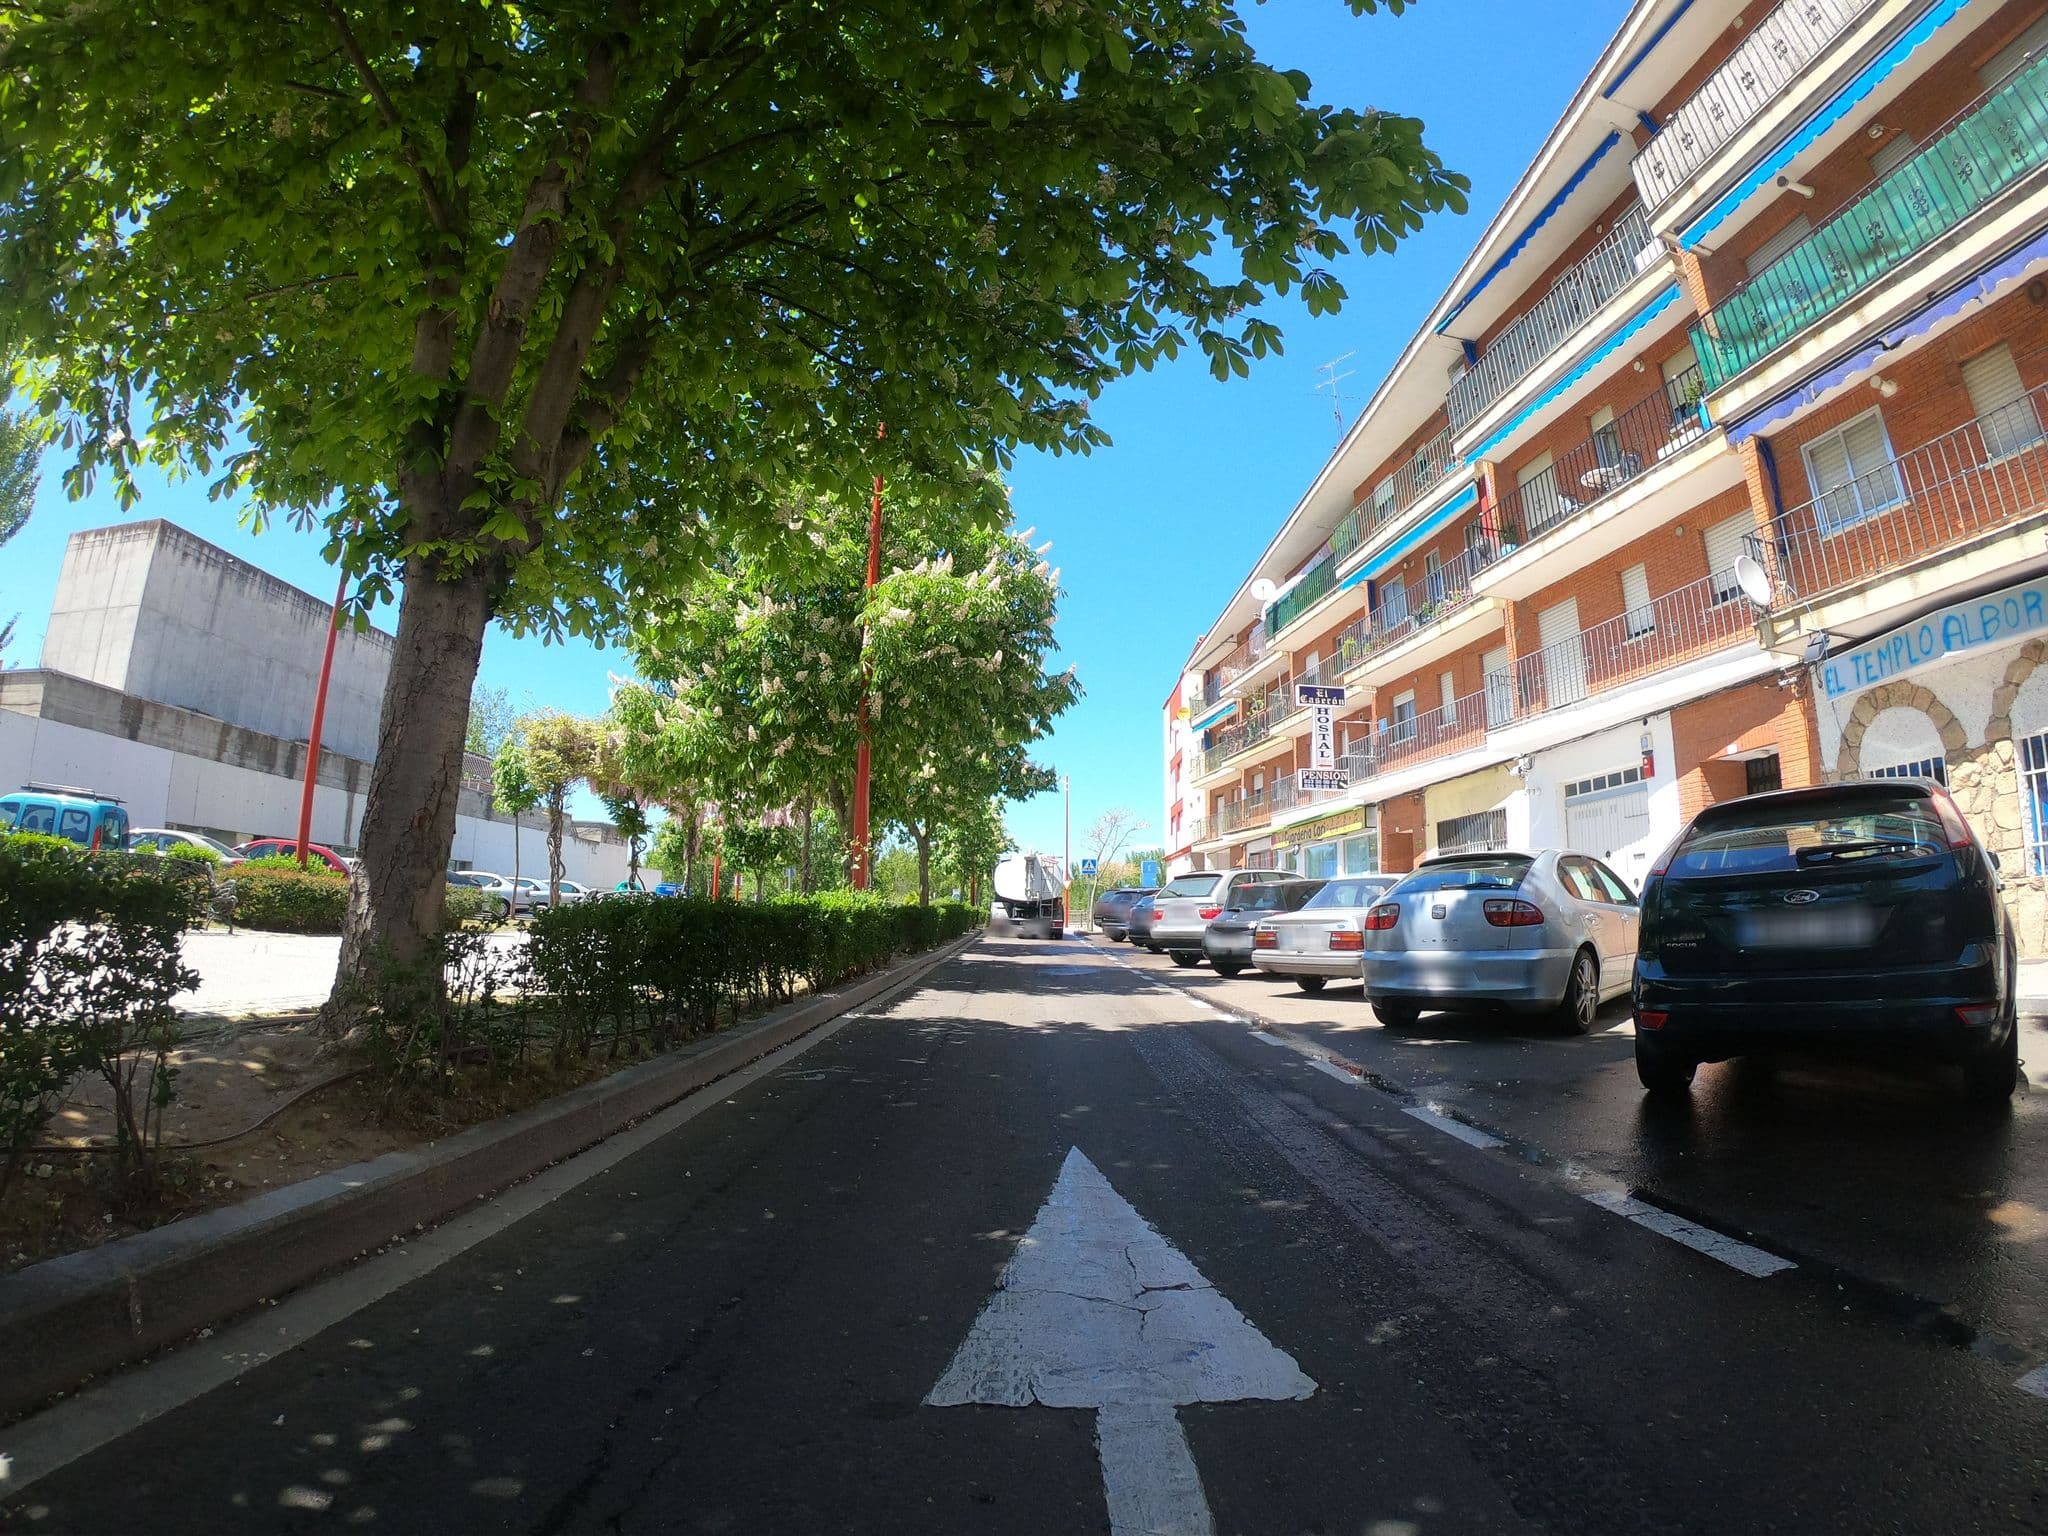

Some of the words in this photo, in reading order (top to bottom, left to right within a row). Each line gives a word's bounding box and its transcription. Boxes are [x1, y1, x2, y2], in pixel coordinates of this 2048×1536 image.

[1825, 664, 1846, 695] EL
[1850, 625, 1934, 688] TEMPLO
[1942, 590, 2043, 651] ALBOR
[1316, 688, 1328, 698] El
[1316, 707, 1331, 759] HOSTAL
[1303, 770, 1348, 780] PENSION
